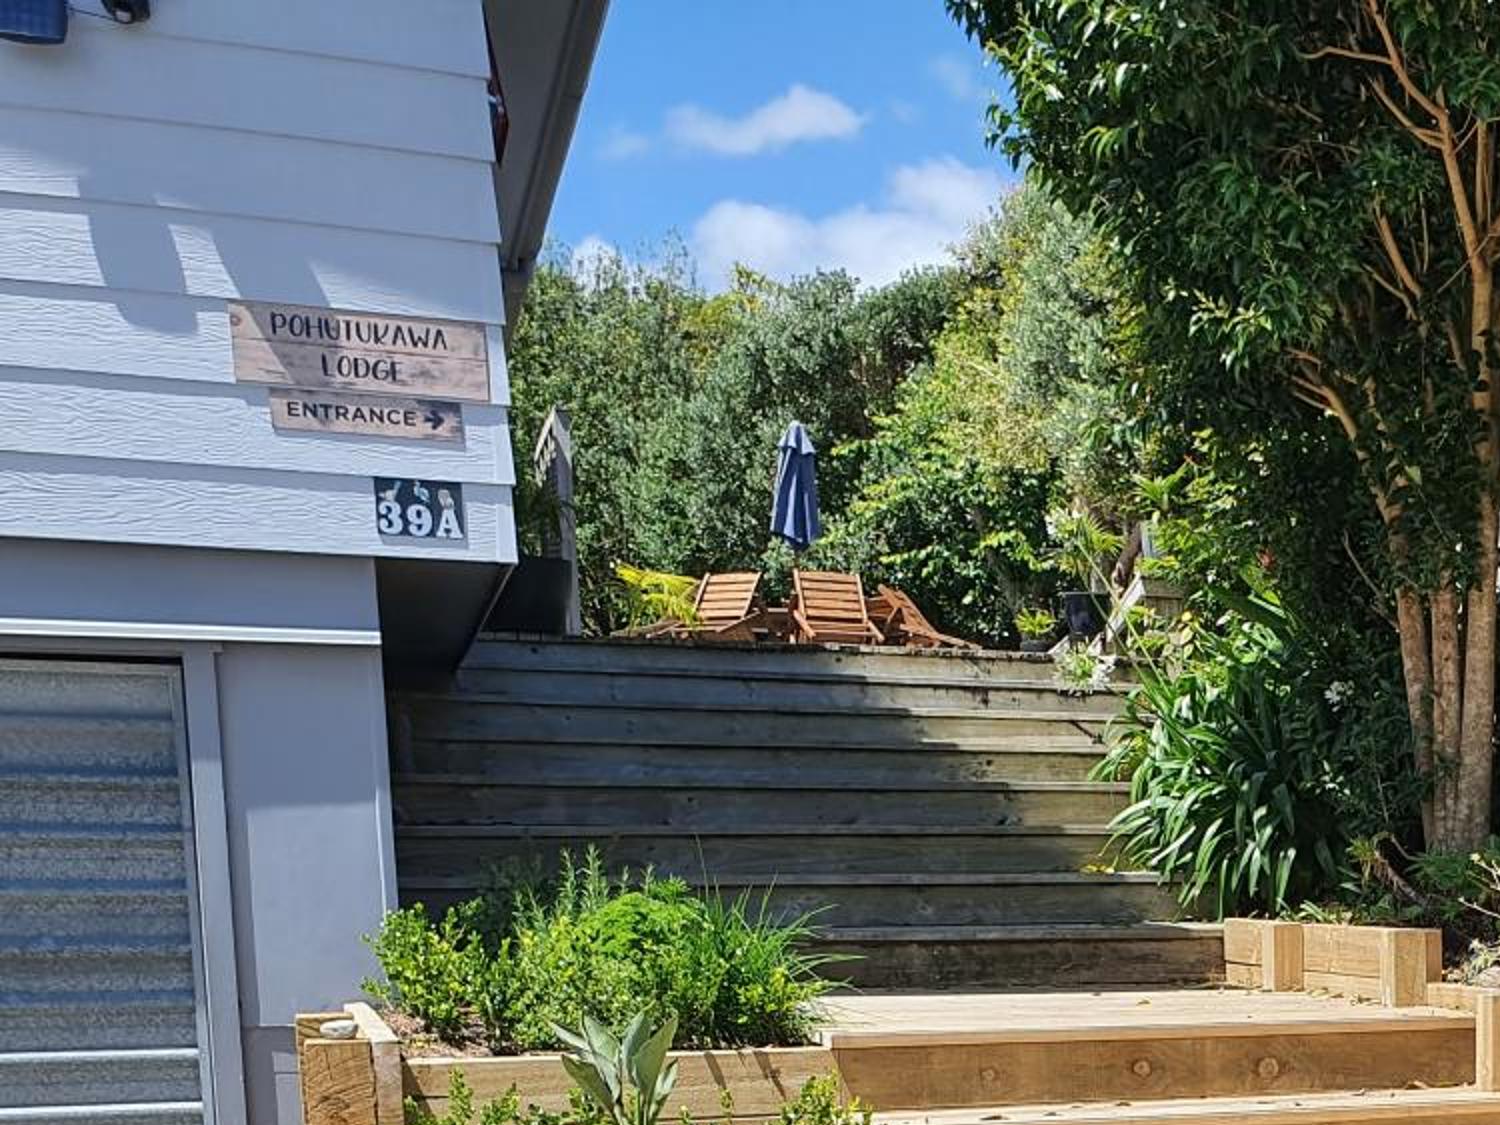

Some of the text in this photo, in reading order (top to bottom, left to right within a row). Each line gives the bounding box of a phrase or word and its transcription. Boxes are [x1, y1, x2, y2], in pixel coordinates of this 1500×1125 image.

[270, 312, 448, 350] POHUTUKAWA
[320, 353, 402, 382] LODGE
[286, 401, 417, 426] ENTRANCE
[378, 501, 464, 539] 39A
